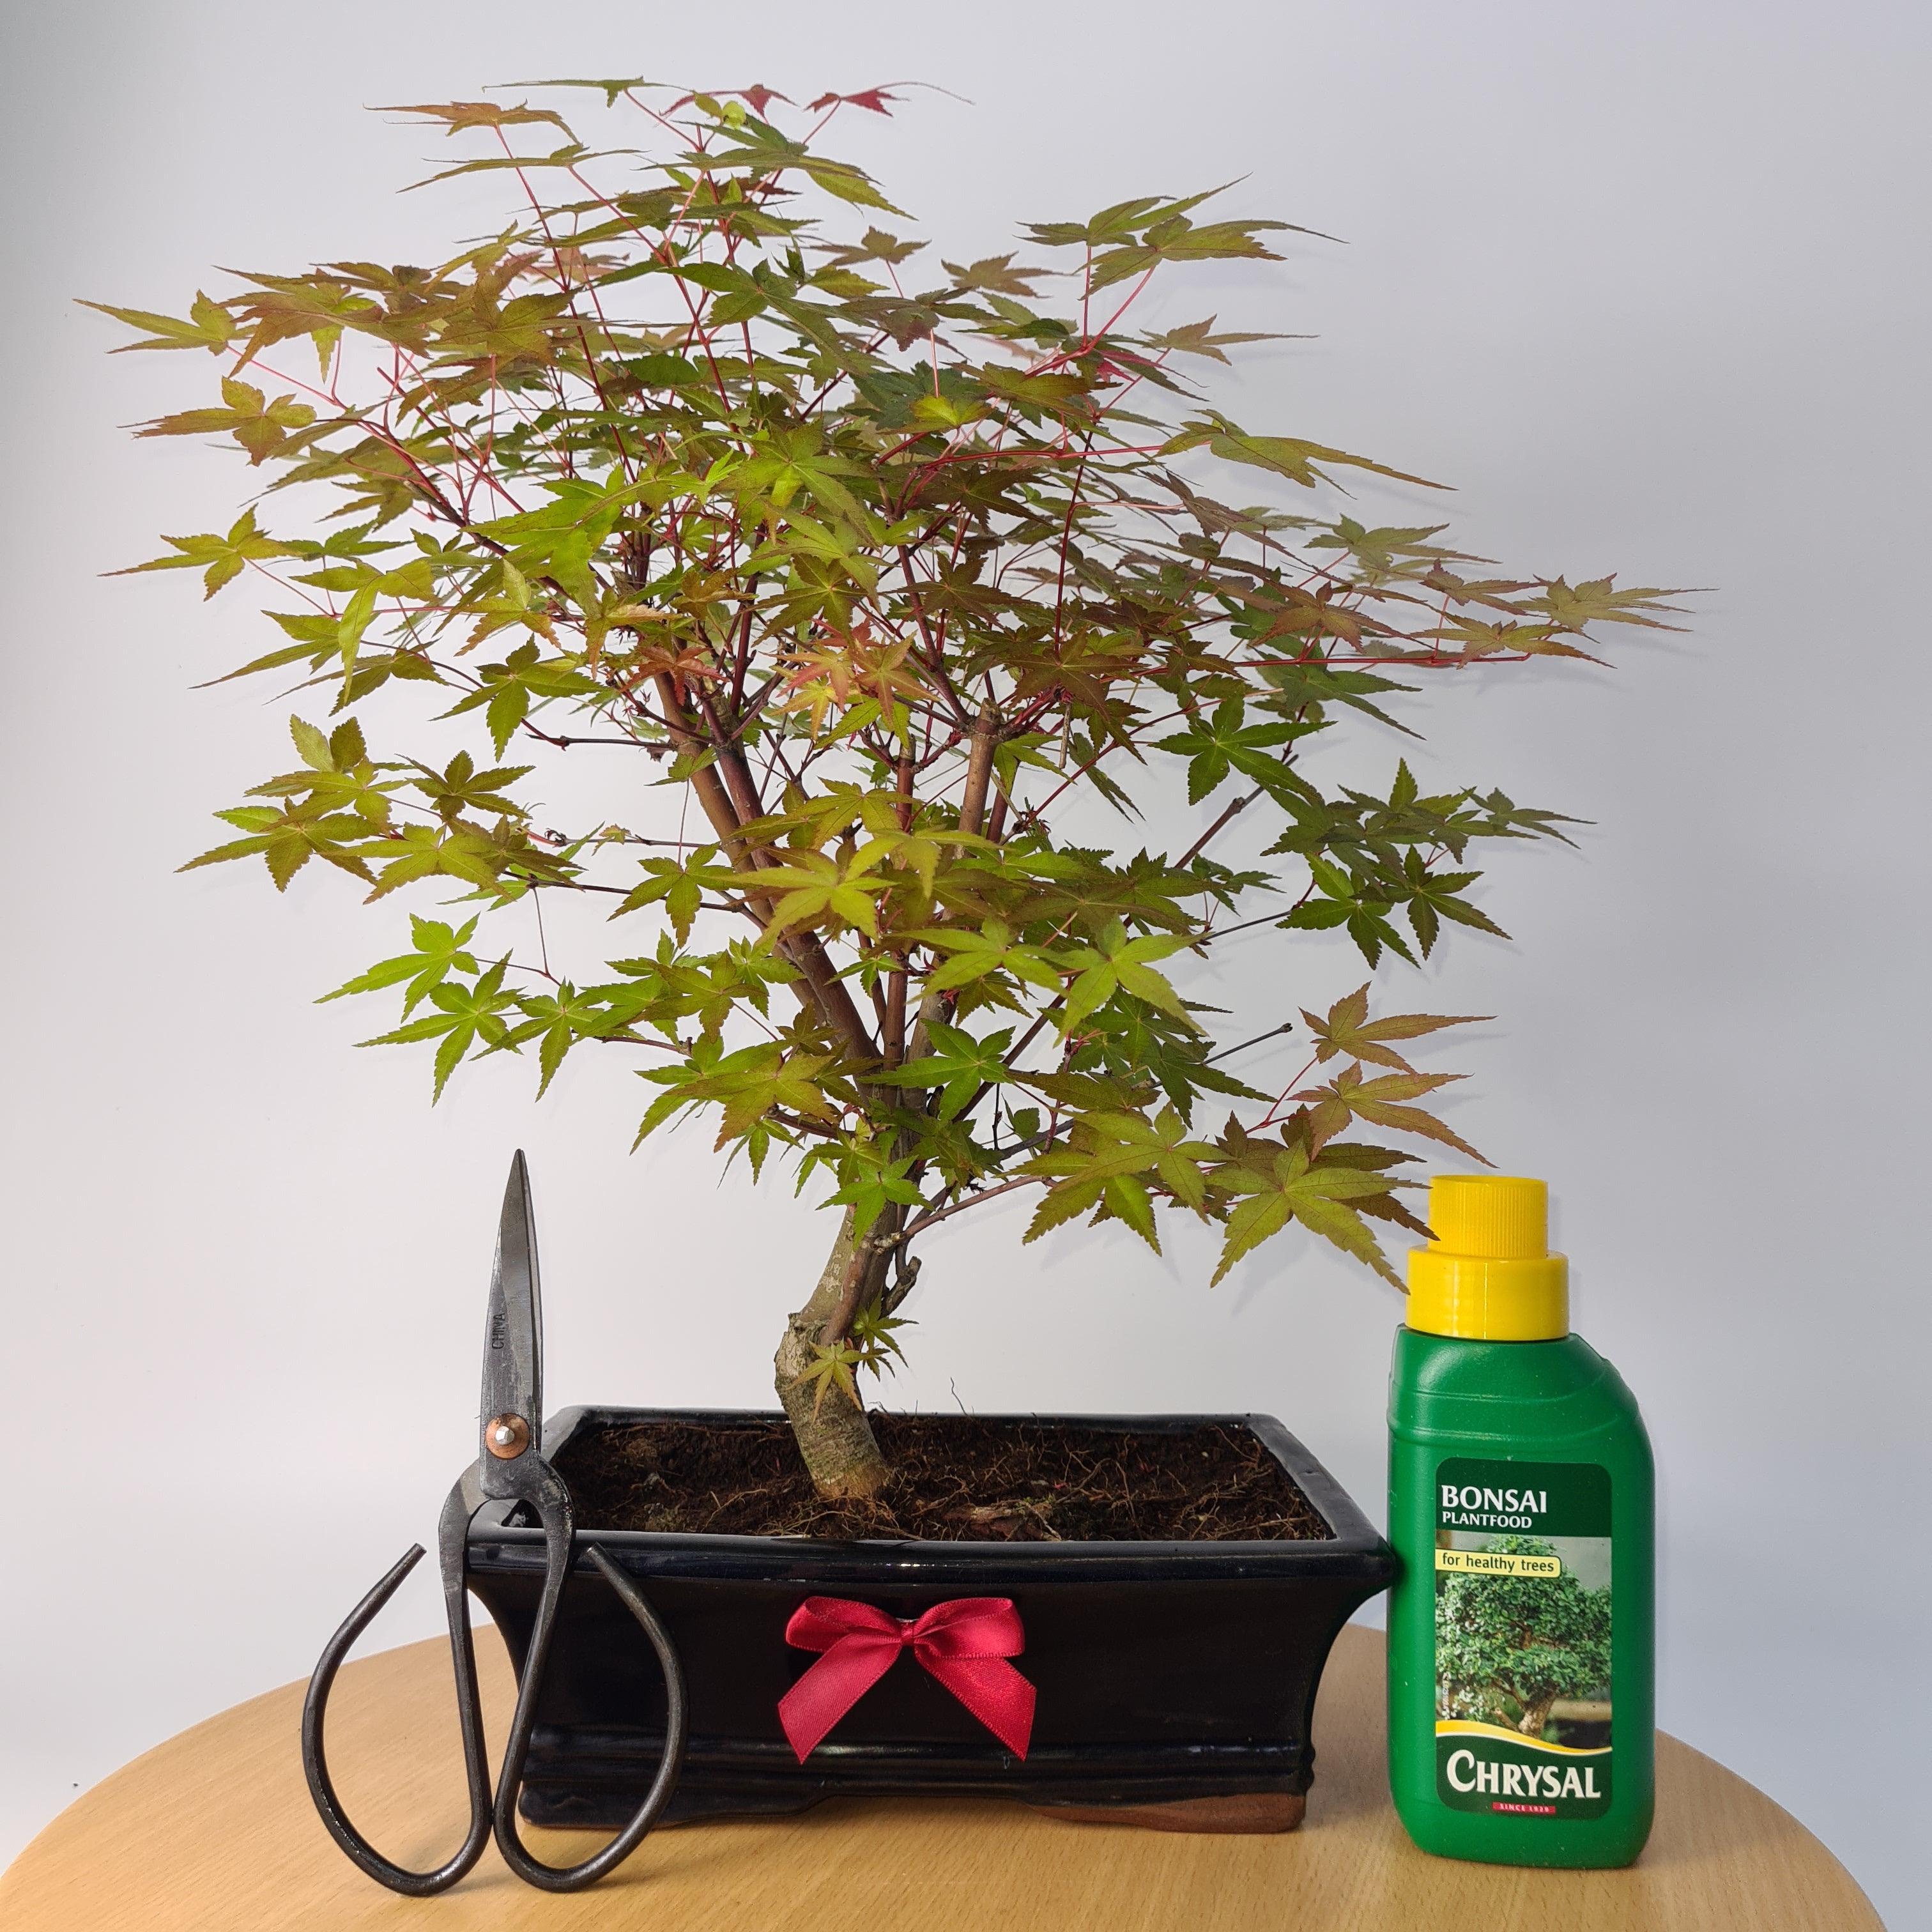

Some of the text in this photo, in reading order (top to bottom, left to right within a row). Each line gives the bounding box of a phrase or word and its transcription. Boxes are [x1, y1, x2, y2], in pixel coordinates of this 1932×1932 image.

[491, 1312, 506, 1349] CHINA
[1441, 1485, 1547, 1513] BONSAI
[1442, 1511, 1532, 1528] PLANTFOOD
[1443, 1552, 1554, 1573] for healthy trees
[1446, 1749, 1601, 1798] CHRYSAL
[1499, 1803, 1526, 1811] SINCE
